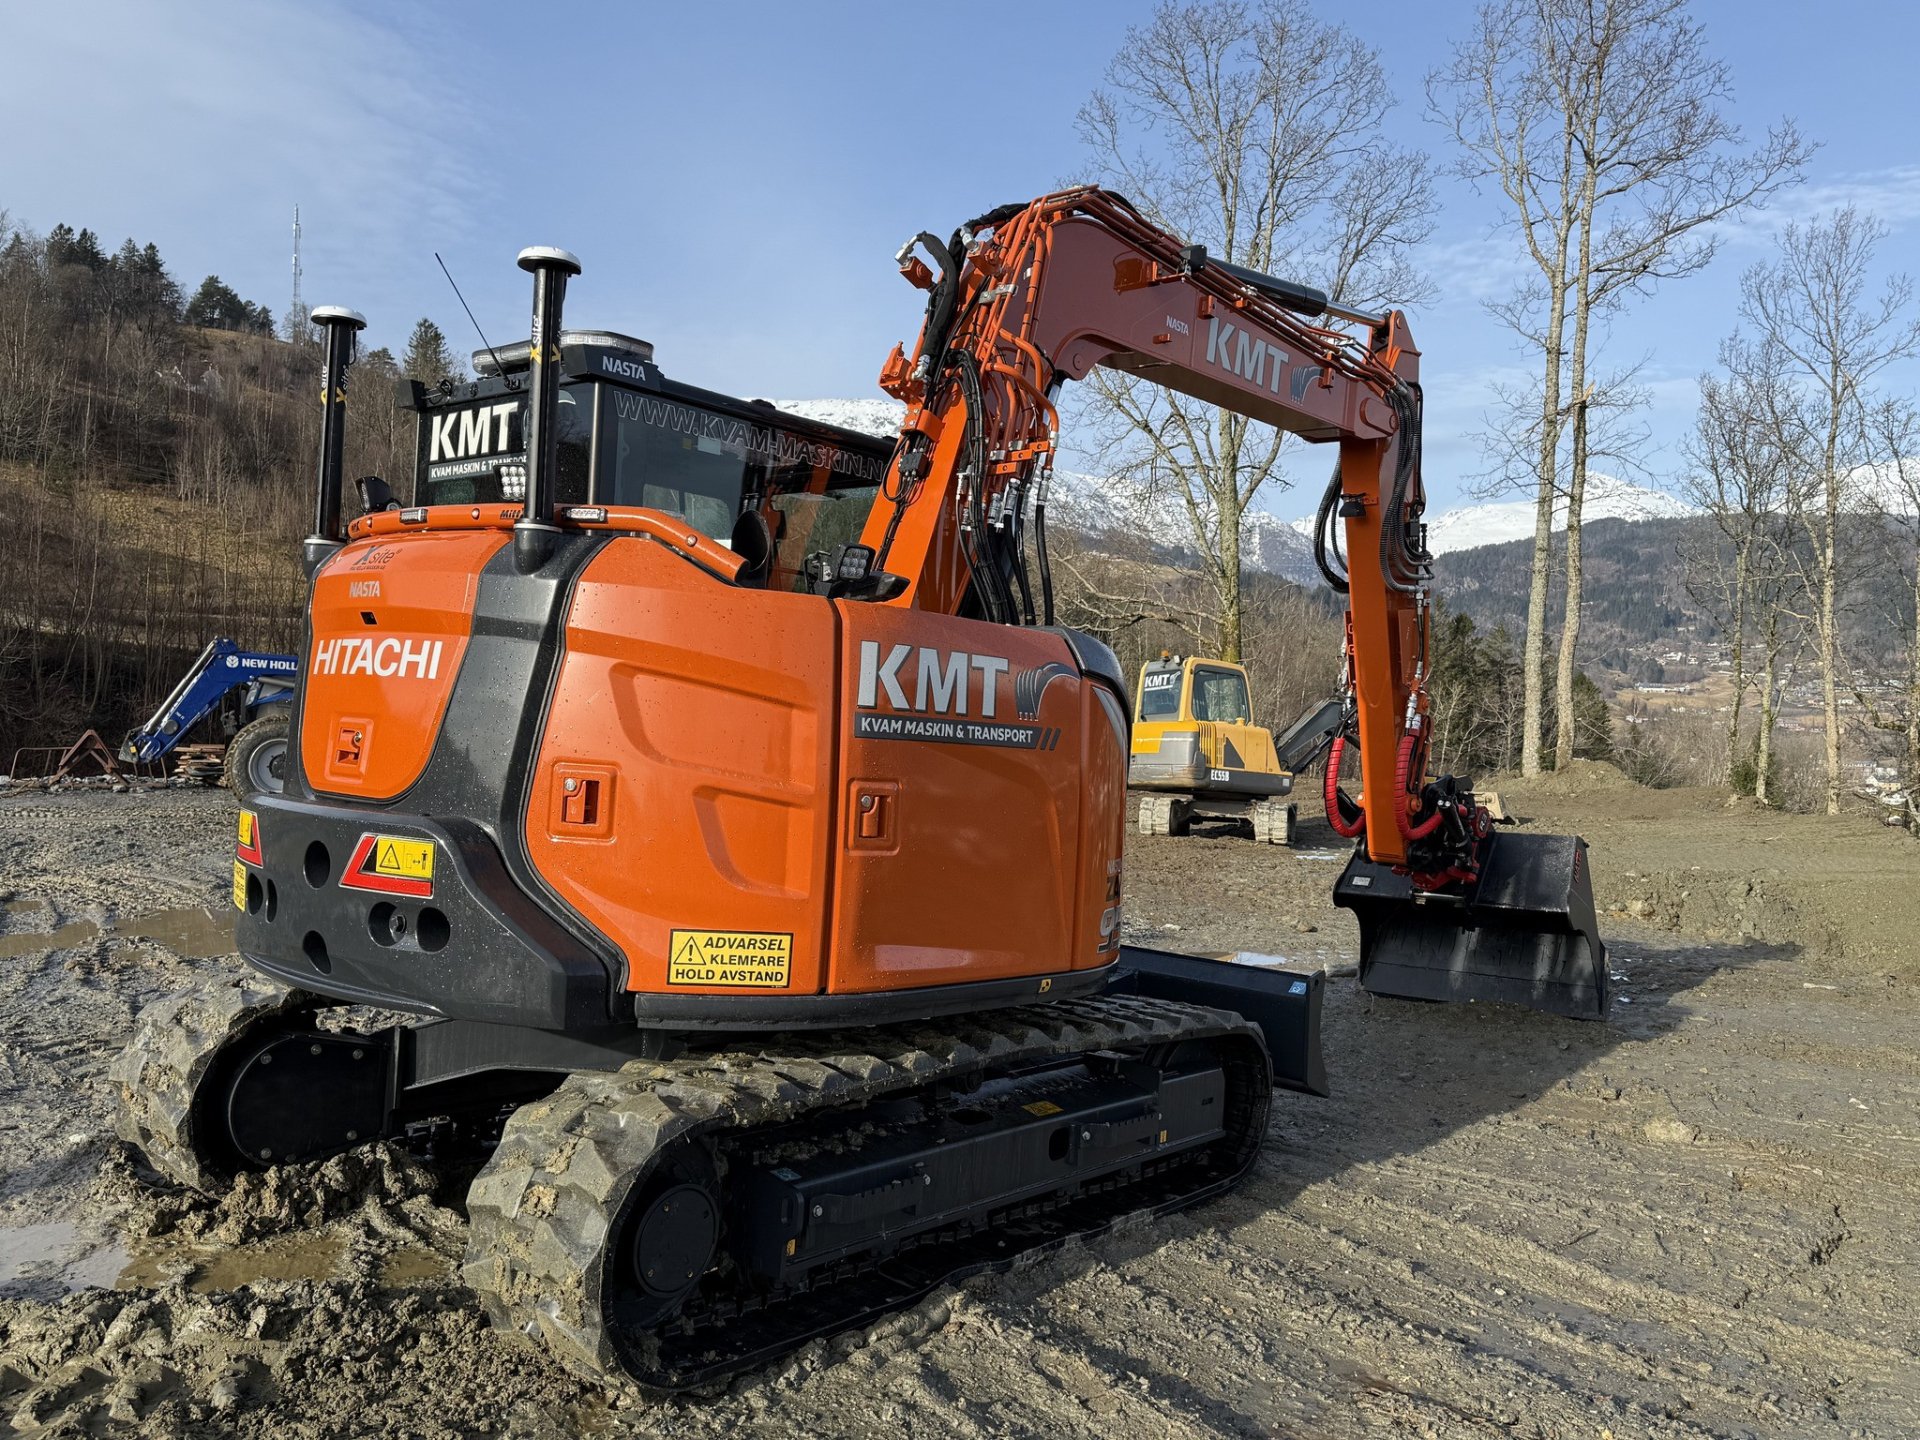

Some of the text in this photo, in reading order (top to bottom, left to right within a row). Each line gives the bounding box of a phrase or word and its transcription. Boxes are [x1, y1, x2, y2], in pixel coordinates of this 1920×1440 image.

[1166, 315, 1189, 336] NASTA
[1206, 316, 1290, 394] KMT
[602, 355, 646, 381] NASTA
[429, 401, 519, 461] KMT
[613, 390, 887, 482] WWW.KVAM-MASKIN.N
[431, 466, 452, 478] KVAM
[452, 462, 480, 475] MASKIN
[350, 580, 381, 597] NASTA
[242, 658, 268, 669] NEW
[313, 638, 443, 679] HITACHI
[857, 640, 1008, 718] KMT
[1144, 673, 1171, 688] KMT
[861, 717, 1033, 744] KVAM MASKIN & TRANSPORT
[703, 936, 786, 951] ADVARSEL
[710, 953, 785, 967] KLEMFARE
[675, 968, 784, 982] HOLD AVSTAND
